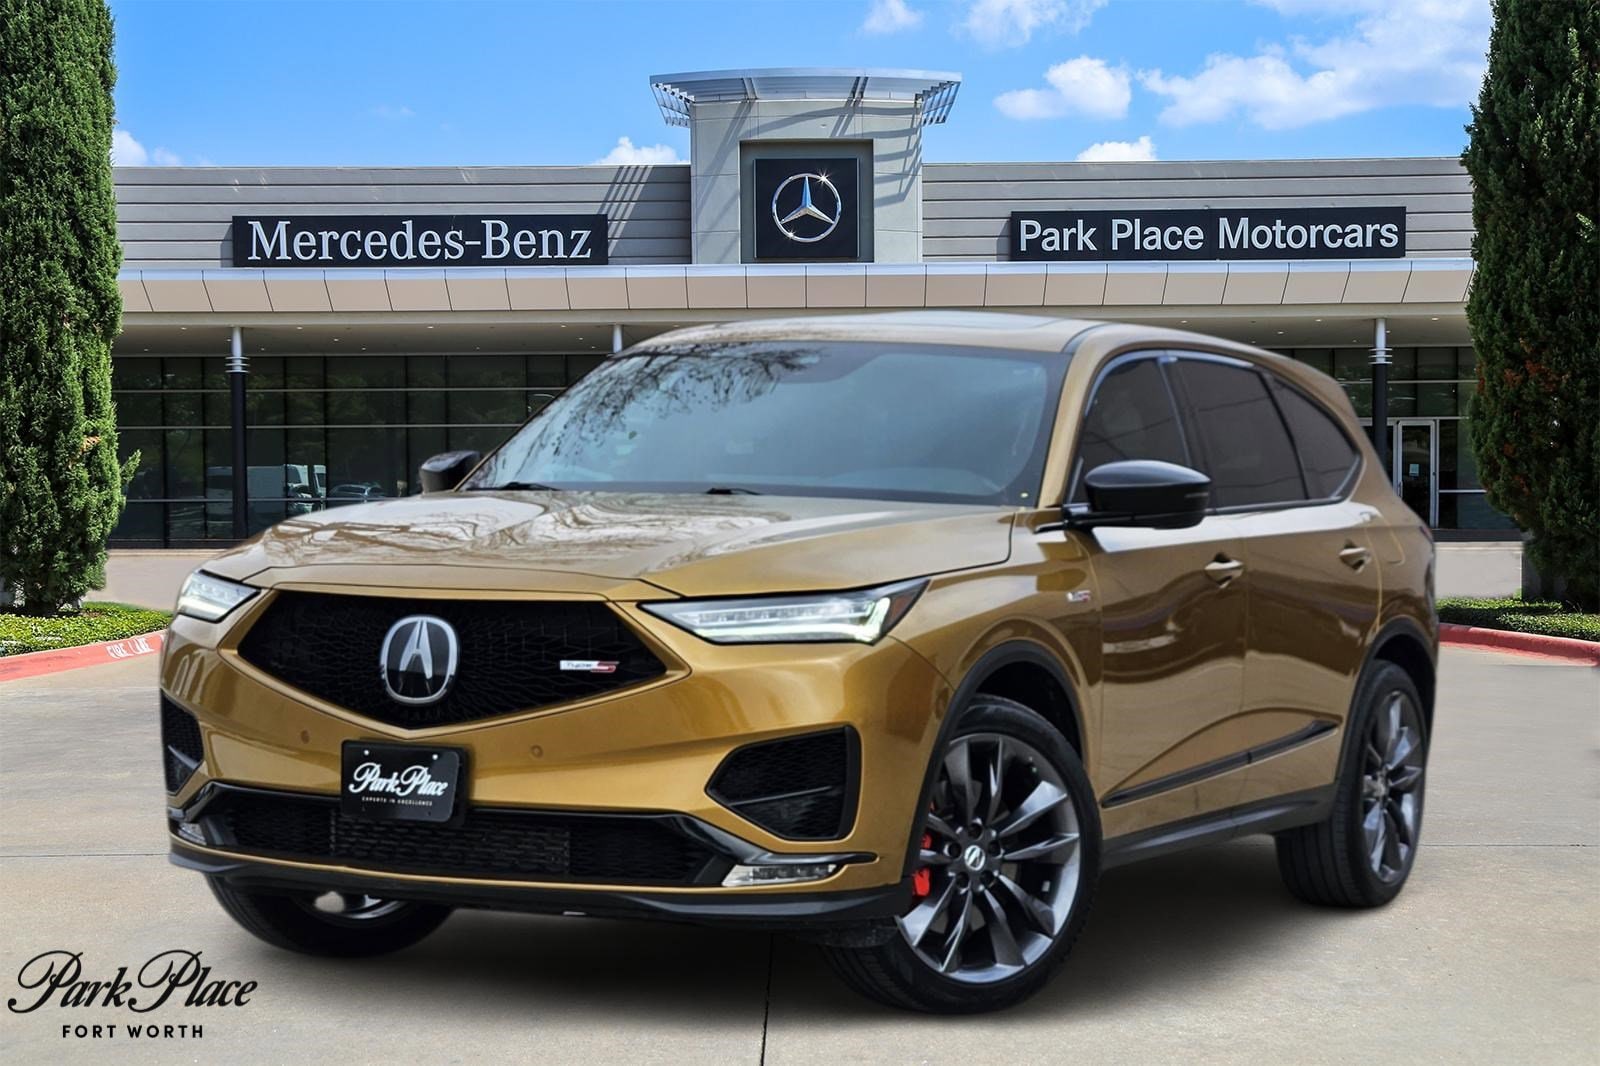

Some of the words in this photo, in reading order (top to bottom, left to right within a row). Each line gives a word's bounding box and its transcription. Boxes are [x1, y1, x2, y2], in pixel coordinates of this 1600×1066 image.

[247, 219, 592, 261] Mercedes-Benz
[1019, 218, 1098, 252] Park
[1110, 218, 1205, 251] Place
[1218, 217, 1400, 250] Motorcars
[348, 761, 400, 794] Park
[395, 764, 449, 797] Place
